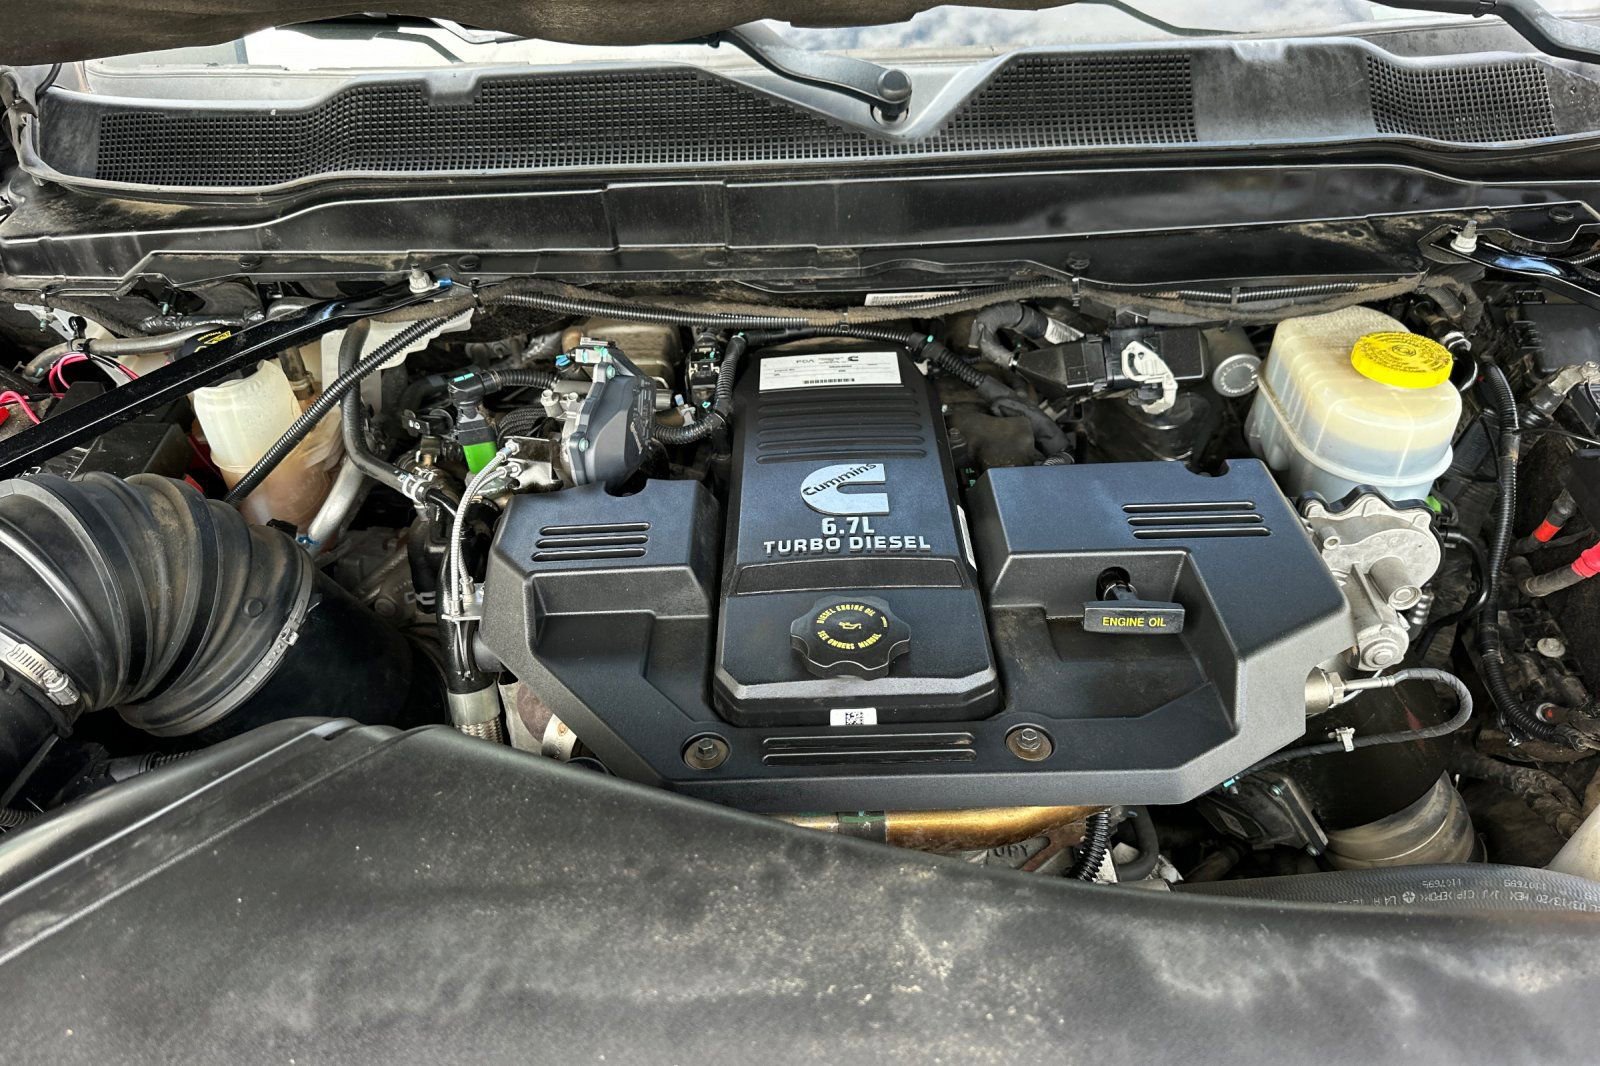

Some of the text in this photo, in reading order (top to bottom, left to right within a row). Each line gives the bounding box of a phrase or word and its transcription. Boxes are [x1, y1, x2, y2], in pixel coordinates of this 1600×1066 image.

[802, 463, 877, 496] Cummins
[821, 516, 875, 535] 6.7L
[763, 535, 931, 555] TURBO DIESEL
[816, 604, 876, 625] DIESEL ENGINE OIL
[1102, 616, 1167, 627] ENGINE OIL
[817, 630, 882, 650] SEE OWNERS MANUAL
